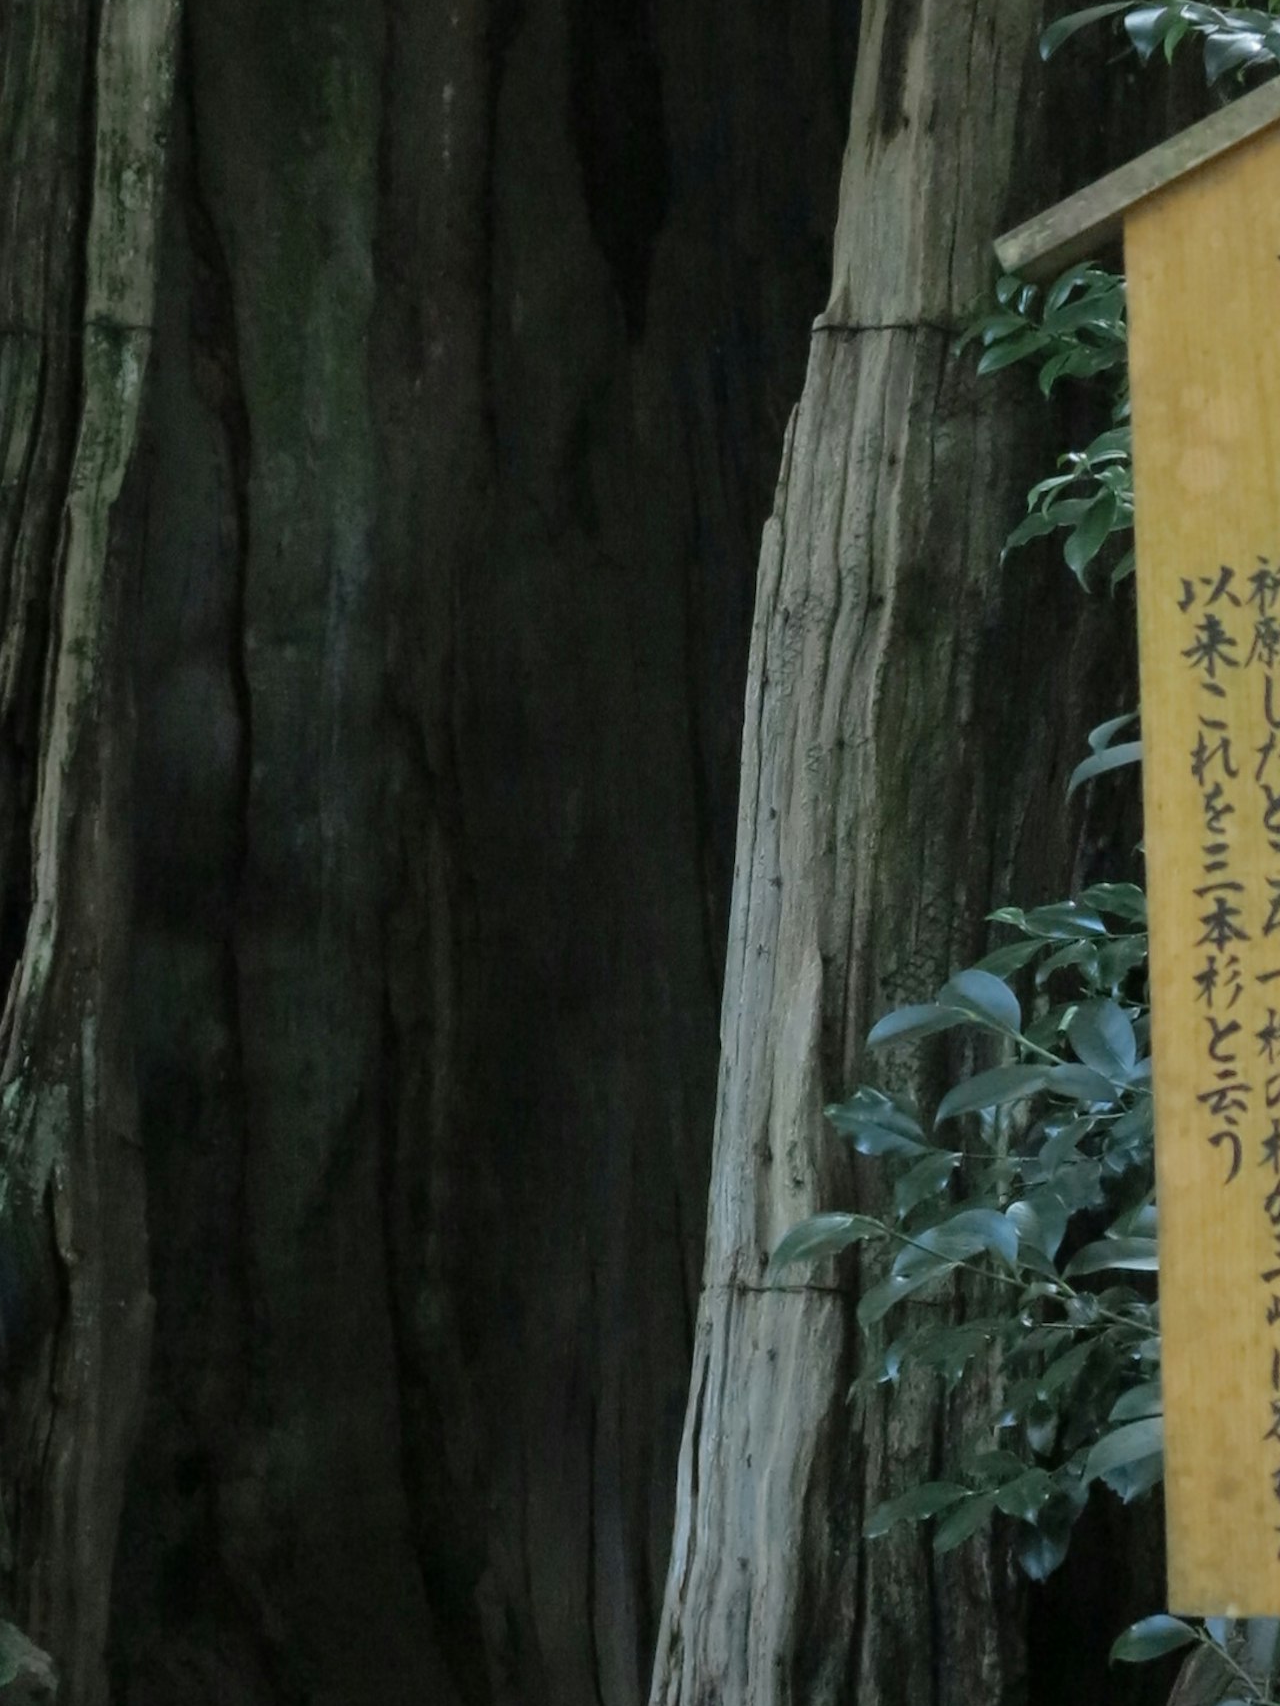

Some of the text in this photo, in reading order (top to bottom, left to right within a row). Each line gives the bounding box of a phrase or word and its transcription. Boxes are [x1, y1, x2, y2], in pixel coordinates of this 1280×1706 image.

[1176, 565, 1254, 1186] 以来これを三本杉と云う
